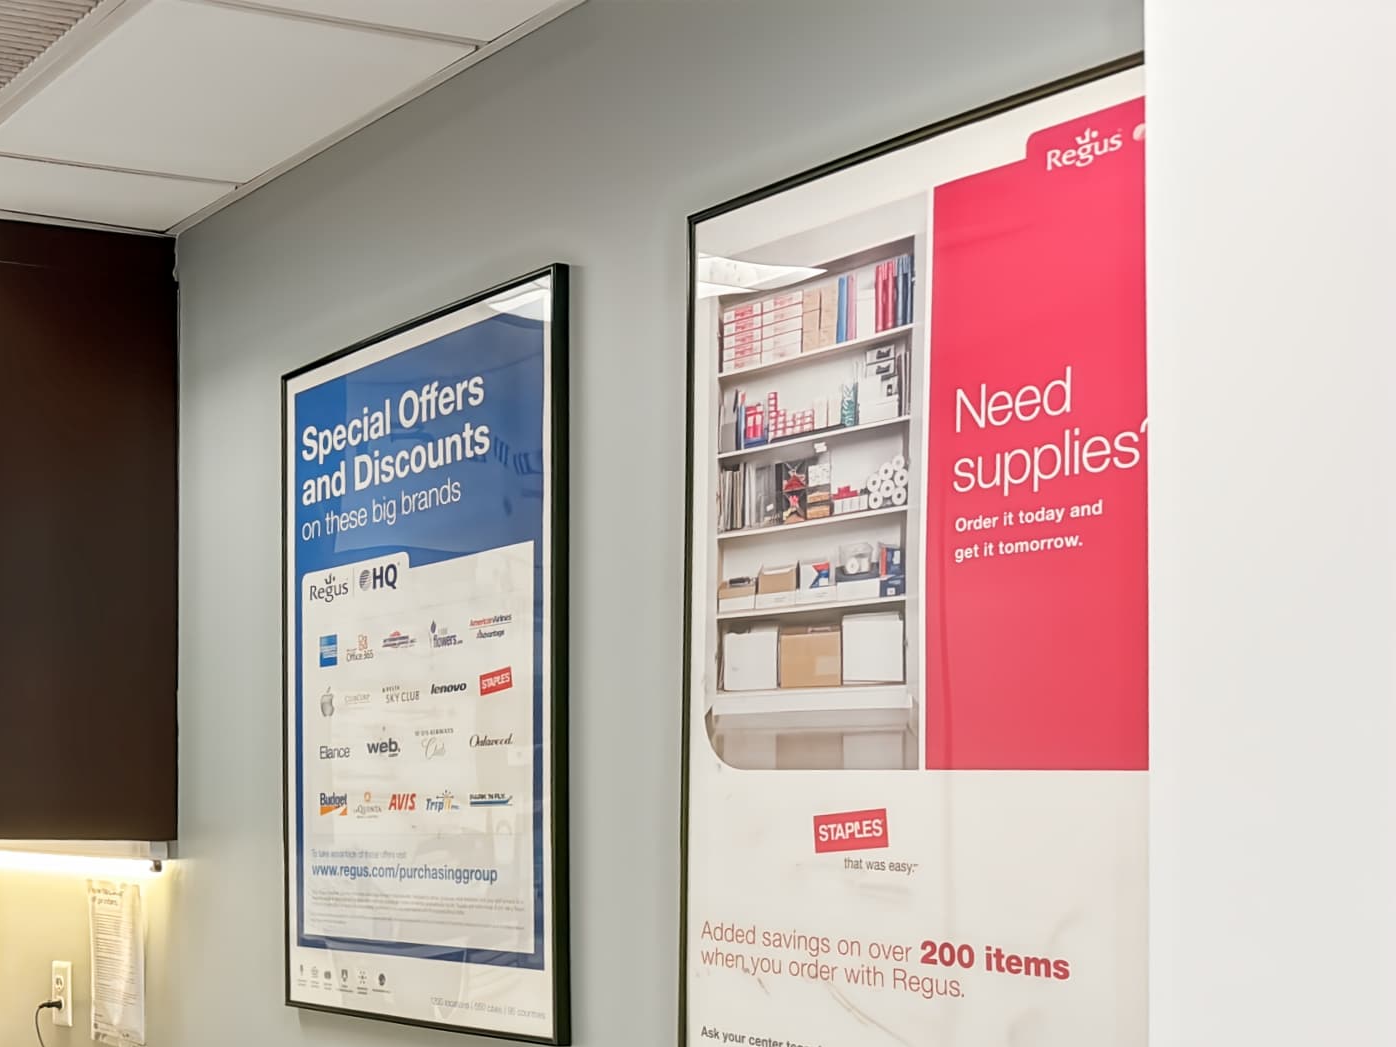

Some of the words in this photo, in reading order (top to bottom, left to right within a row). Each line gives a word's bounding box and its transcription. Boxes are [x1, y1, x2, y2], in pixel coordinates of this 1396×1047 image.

[1046, 131, 1123, 171] Regus
[955, 366, 1072, 433] Need
[301, 398, 391, 464] Special
[399, 375, 485, 428] Offers
[302, 461, 346, 506] and
[354, 422, 491, 492] Discounts
[301, 519, 321, 541] on
[325, 507, 368, 535] these
[372, 496, 397, 526] big
[401, 478, 461, 516] brands
[955, 516, 999, 532] Order
[1003, 512, 1014, 527] it
[1019, 506, 1065, 523] today
[1070, 499, 1103, 518] and
[955, 545, 979, 563] get
[983, 542, 994, 556] it
[999, 535, 1083, 555] tomorrow.
[309, 580, 349, 602] Regus
[372, 564, 398, 590] HQ
[430, 682, 467, 695] lenovo
[481, 672, 510, 691] STAPLES
[319, 792, 348, 808] Budget
[388, 793, 417, 811] AVIS
[817, 818, 883, 842] STAPLES
[312, 863, 498, 885] www.regus.com/purchasinggroup
[844, 857, 863, 870] that
[865, 859, 886, 871] was
[701, 920, 756, 945] Added
[762, 928, 830, 957] savings
[837, 938, 861, 957] on
[868, 940, 912, 963] over
[920, 940, 975, 968] 200
[985, 945, 1070, 980] items
[701, 949, 745, 970] when
[750, 957, 782, 977] you
[789, 959, 838, 982] order
[844, 964, 885, 988] with
[892, 968, 966, 999] Regus.
[700, 1025, 720, 1041] Ask
[722, 1031, 746, 1047] your
